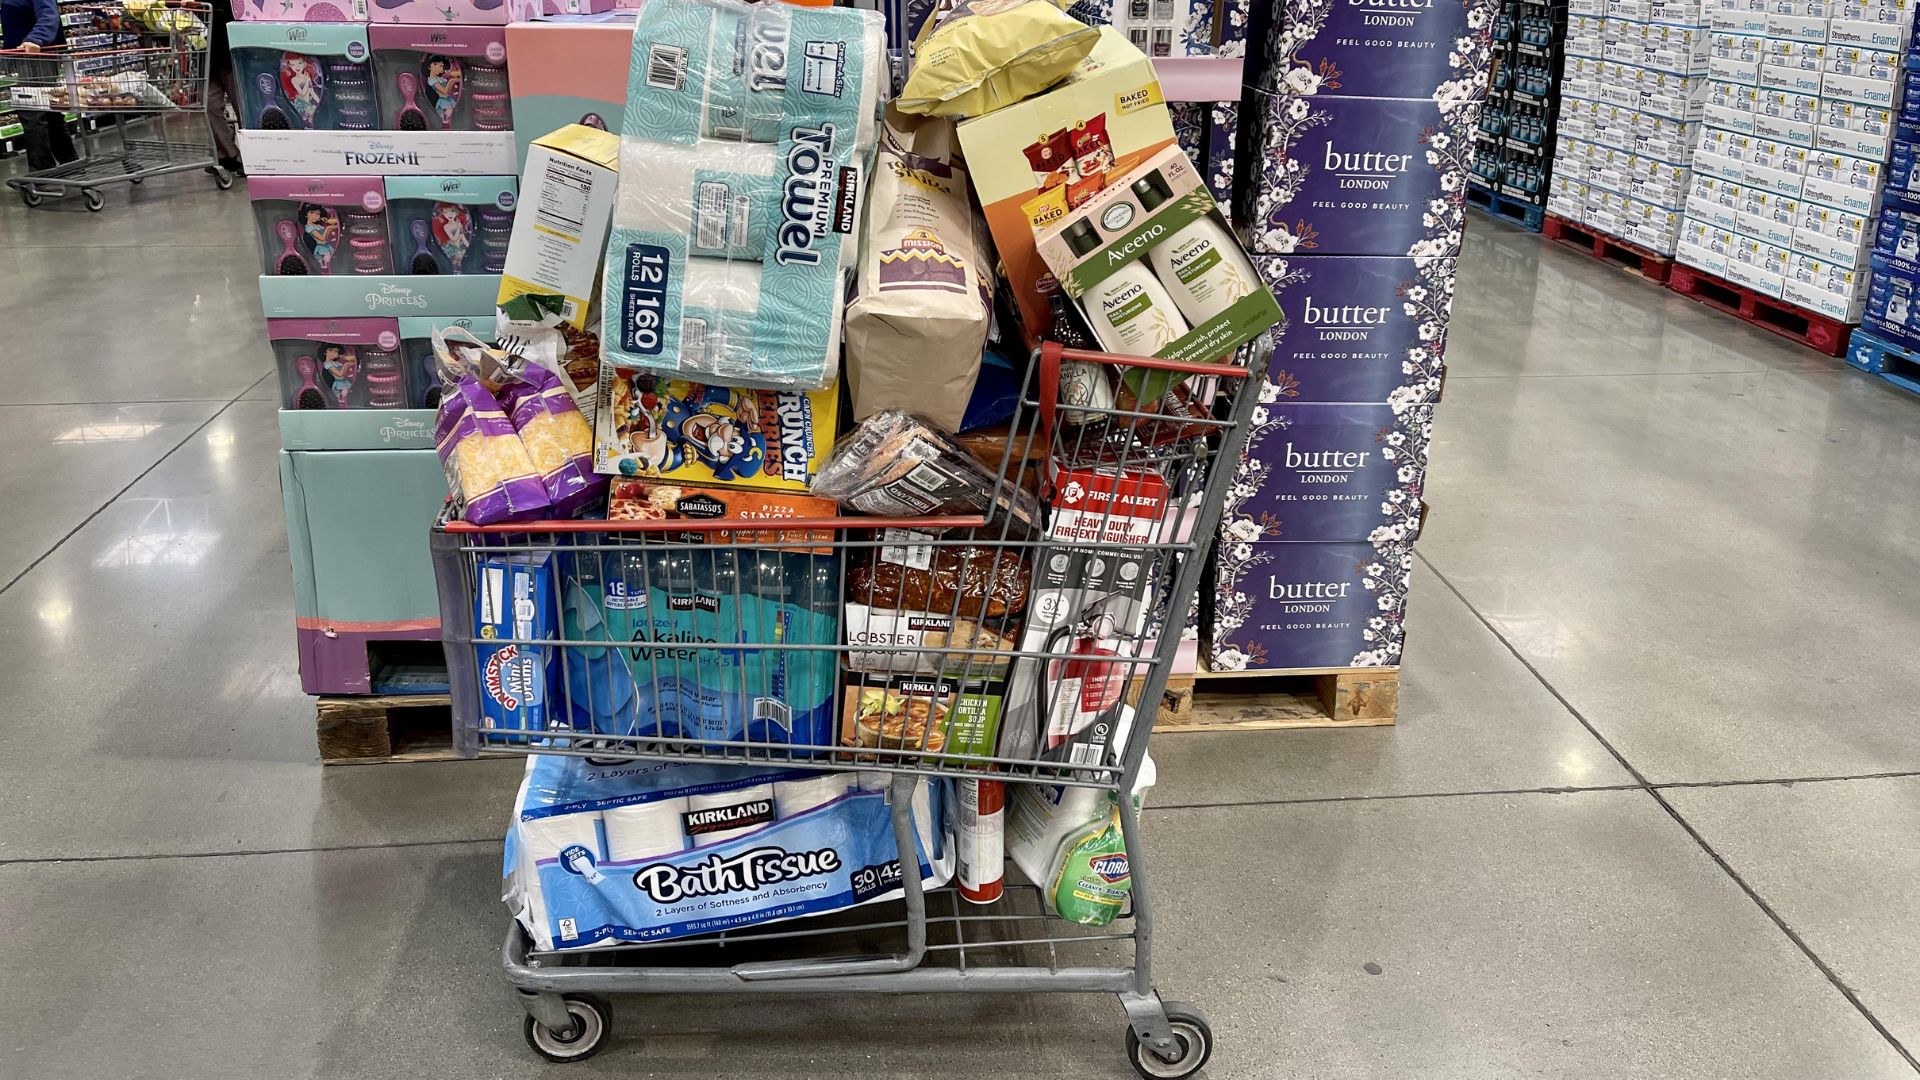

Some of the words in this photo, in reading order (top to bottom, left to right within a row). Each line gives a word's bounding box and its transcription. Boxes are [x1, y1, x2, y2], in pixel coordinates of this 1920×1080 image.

[1364, 15, 1415, 27] LONDON
[1802, 27, 1825, 39] Enamel
[1871, 32, 1899, 46] Enamel
[1336, 38, 1360, 46] FEEL
[1364, 39, 1393, 47] GOOD
[1397, 40, 1436, 49] BEAUTY
[1796, 78, 1819, 91] Enamel
[1120, 89, 1149, 104] BAKED
[1863, 89, 1891, 103] Enamel
[1788, 129, 1811, 143] Enamel
[1324, 140, 1413, 172] butter
[1857, 141, 1884, 156] Enamel
[344, 151, 405, 166] FROZEN
[407, 151, 419, 166] II
[549, 157, 575, 170] Nutrition
[576, 165, 592, 176] Facts
[1340, 179, 1390, 190] LONDON
[1777, 178, 1800, 194] Enamel
[778, 125, 835, 265] Towel
[815, 159, 833, 237] PREMIUM
[842, 169, 857, 232] KIRKLAND
[1843, 195, 1870, 211] Enamel
[1033, 207, 1063, 225] BAKED
[903, 239, 943, 250] mission
[1829, 247, 1855, 264] Enamel
[631, 251, 641, 281] ROLLS
[641, 254, 664, 283] 12
[1895, 259, 1911, 270] 100%
[365, 293, 427, 310] PRINCESS
[1821, 300, 1846, 316] Enamel
[1304, 296, 1391, 324] butter
[634, 297, 660, 349] 160
[1885, 321, 1900, 333] 100%
[1319, 331, 1369, 341] LONDON
[1060, 368, 1088, 380] ANILLA
[777, 392, 808, 482] RUNCH
[1285, 442, 1370, 468] butter
[1300, 474, 1348, 484] LONDON
[1088, 490, 1119, 502] FIRST
[680, 501, 722, 514] SABATASSO'S
[762, 504, 795, 513] PIZZA
[1108, 520, 1135, 532] DUTY
[1055, 525, 1078, 537] FIRE
[1080, 528, 1150, 544] EXTNGUISHER
[1269, 574, 1352, 600] butter
[1284, 604, 1330, 613] LONDON
[630, 628, 718, 651] Akaline
[849, 631, 916, 646] LOBSTER
[587, 772, 596, 782] 2
[601, 766, 649, 781] Layers
[627, 794, 648, 803] SAFE
[688, 801, 771, 826] KIRKLAND
[854, 869, 876, 889] 30
[880, 862, 902, 878] 42
[1094, 861, 1129, 875] CLORO
[857, 882, 877, 896] ROLLS
[656, 909, 662, 917] 2
[664, 904, 695, 917] Layers
[697, 902, 707, 910] of
[709, 893, 750, 910] Softness
[752, 890, 770, 901] and
[772, 880, 828, 898] Absorbency
[650, 926, 672, 936] SAFE
